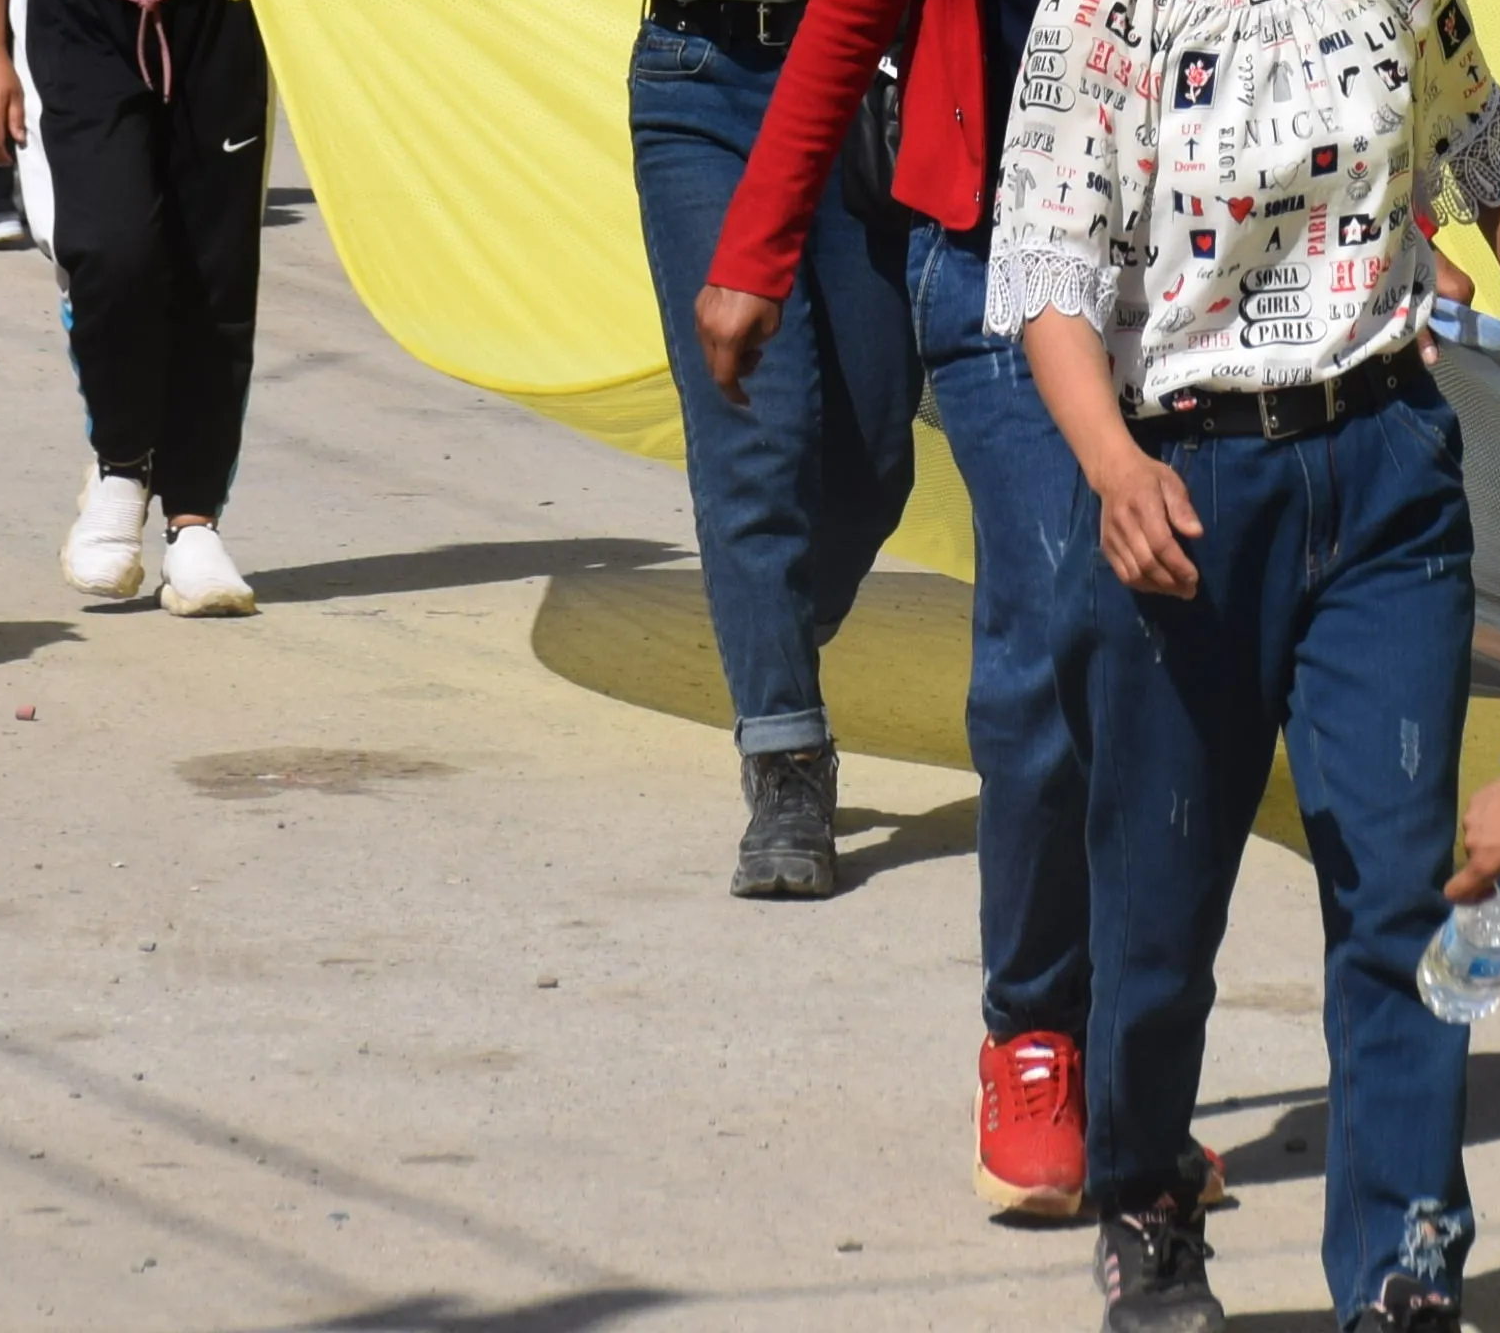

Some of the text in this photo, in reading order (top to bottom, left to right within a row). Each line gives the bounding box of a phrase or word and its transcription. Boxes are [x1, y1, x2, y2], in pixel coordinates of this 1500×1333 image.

[1079, 76, 1127, 112] LOVE
[1181, 124, 1203, 137] UP
[1242, 106, 1344, 151] NICE
[1219, 126, 1237, 185] LOVE
[1056, 164, 1077, 180] UP
[1174, 160, 1207, 173] Down
[1041, 198, 1075, 216] Down
[1264, 194, 1306, 219] SONIA
[1265, 225, 1282, 253] A
[1307, 202, 1328, 258] PARIS
[1256, 266, 1300, 287] SONIA
[1256, 295, 1301, 315] GIRLS
[1258, 321, 1314, 342] PARIS
[1261, 366, 1313, 386] LOVE
